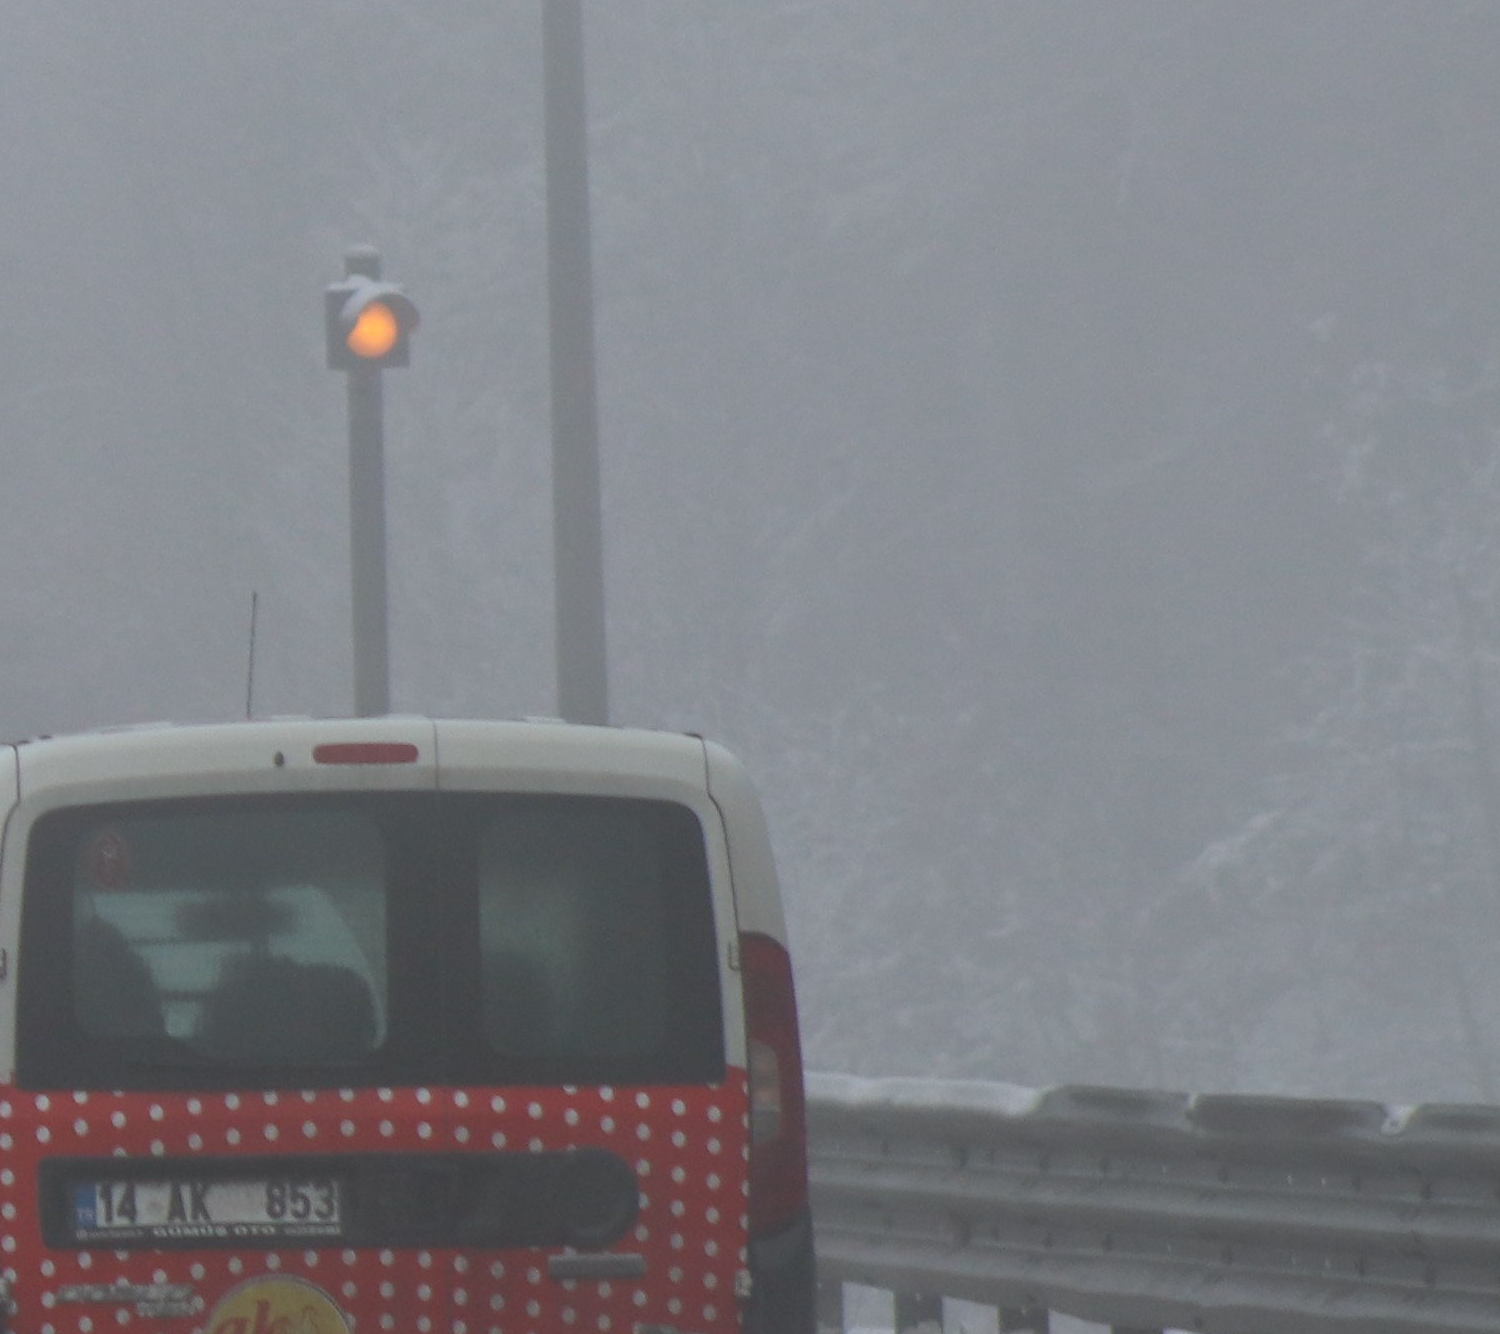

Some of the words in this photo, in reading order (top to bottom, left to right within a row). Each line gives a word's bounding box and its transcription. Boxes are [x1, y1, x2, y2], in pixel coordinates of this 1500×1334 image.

[99, 1181, 137, 1223] 14
[168, 1181, 211, 1223] AK
[266, 1180, 336, 1220] 853
